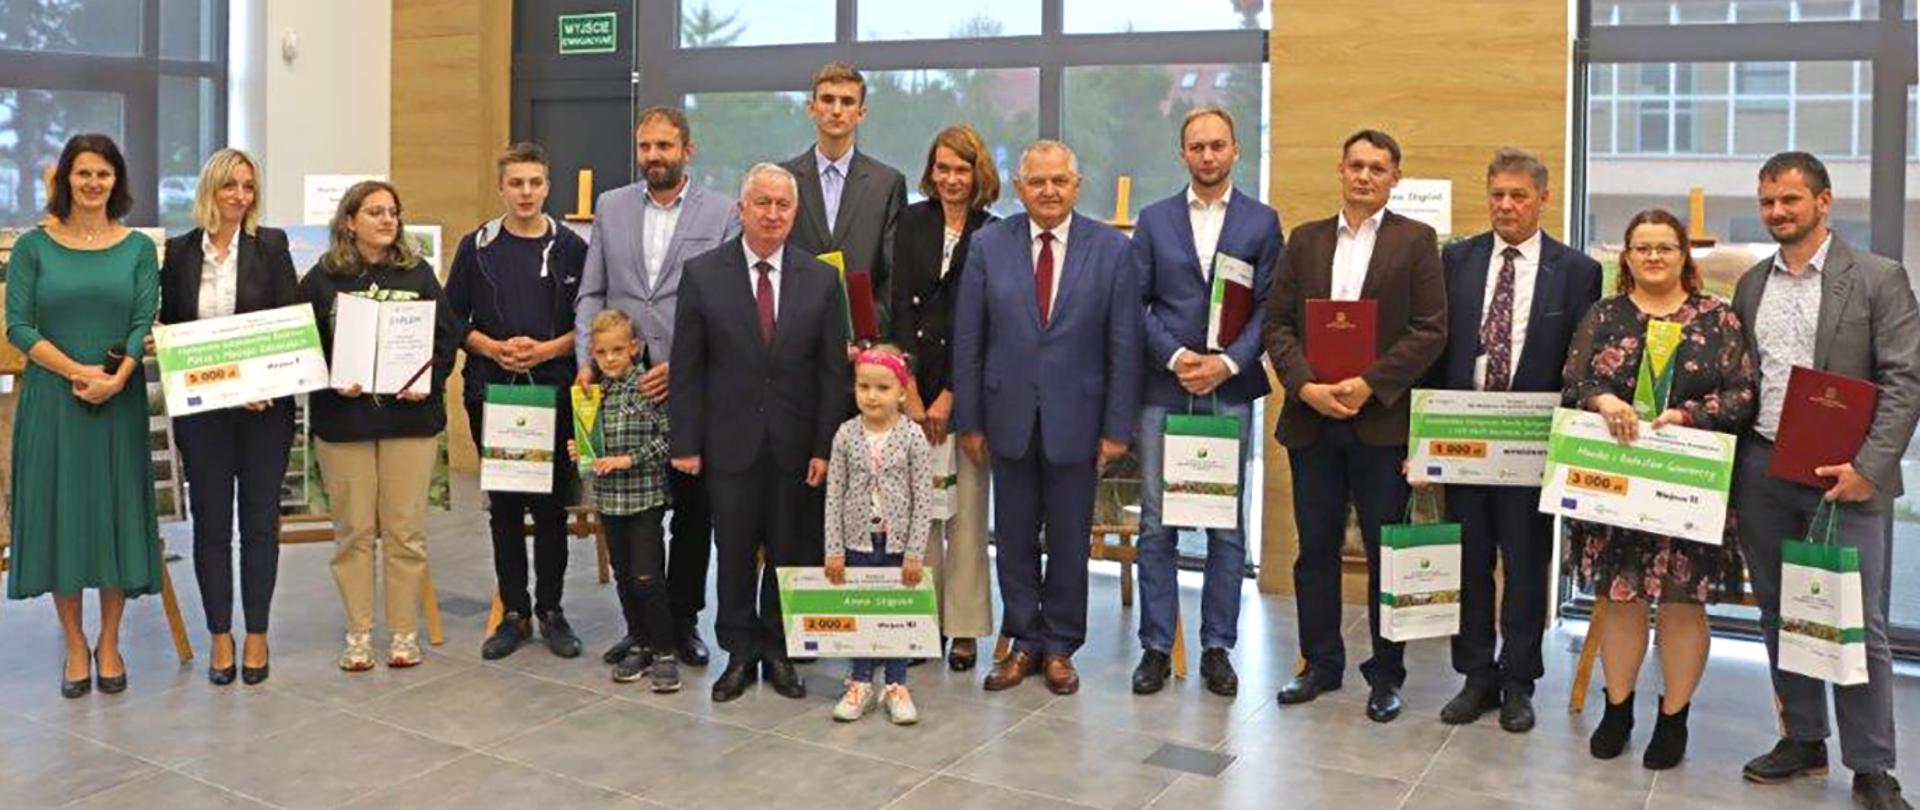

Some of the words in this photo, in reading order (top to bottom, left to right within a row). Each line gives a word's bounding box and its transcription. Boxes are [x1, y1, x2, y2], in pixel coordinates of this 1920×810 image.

[564, 20, 609, 34] WYJŚCIE
[1571, 472, 1581, 484] 3
[1585, 475, 1611, 490] 000
[808, 619, 816, 629] 2
[818, 618, 842, 629] 000
